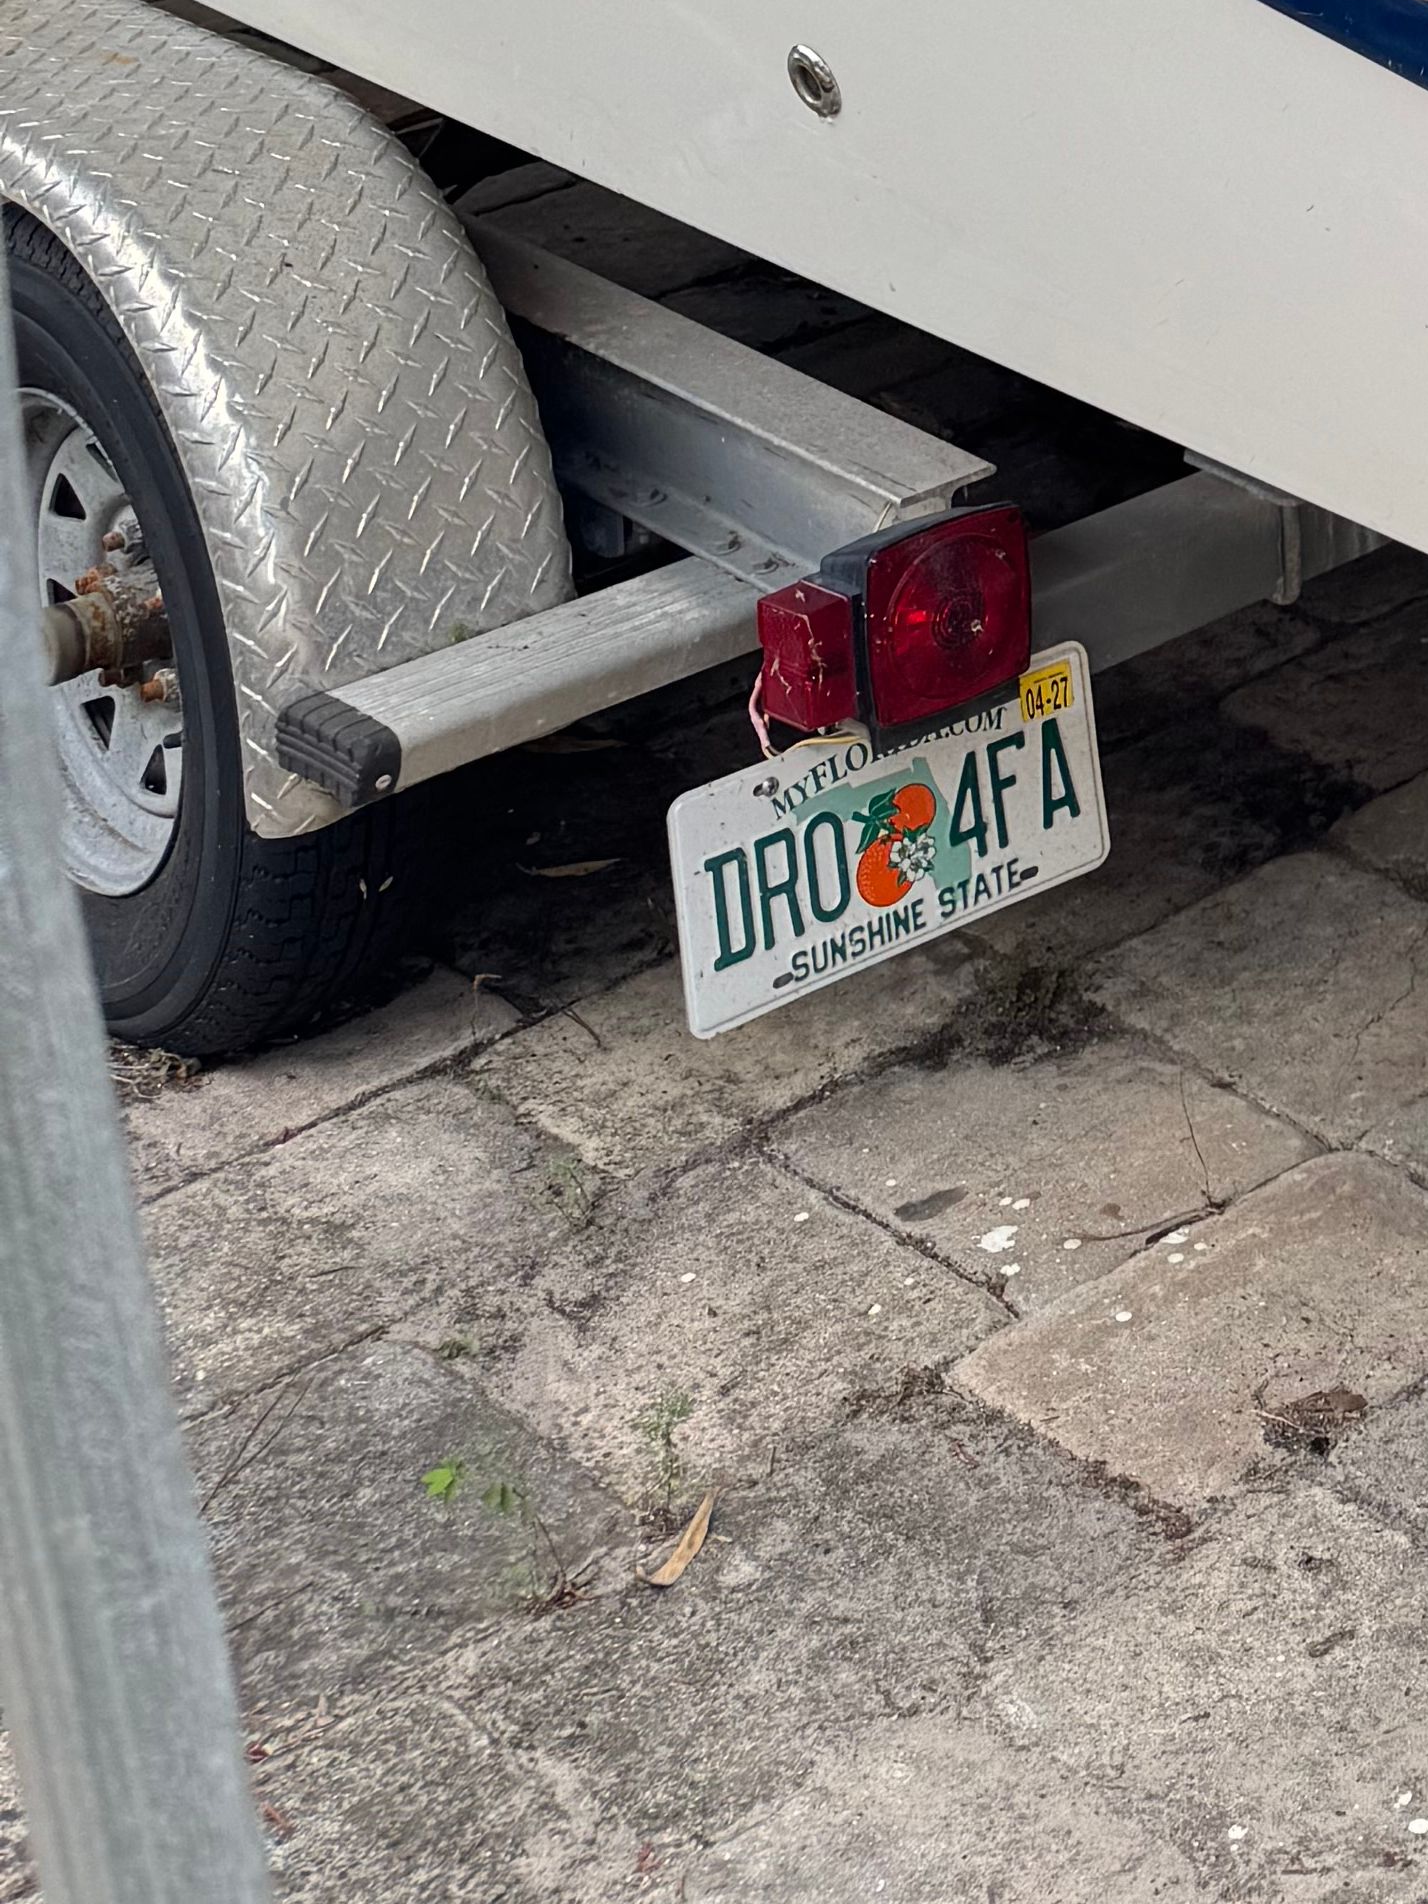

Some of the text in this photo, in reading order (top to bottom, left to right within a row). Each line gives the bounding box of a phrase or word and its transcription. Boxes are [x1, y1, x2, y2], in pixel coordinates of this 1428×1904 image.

[949, 718, 1082, 858] 4FA
[790, 857, 1021, 983] SUNSHINE STATE
